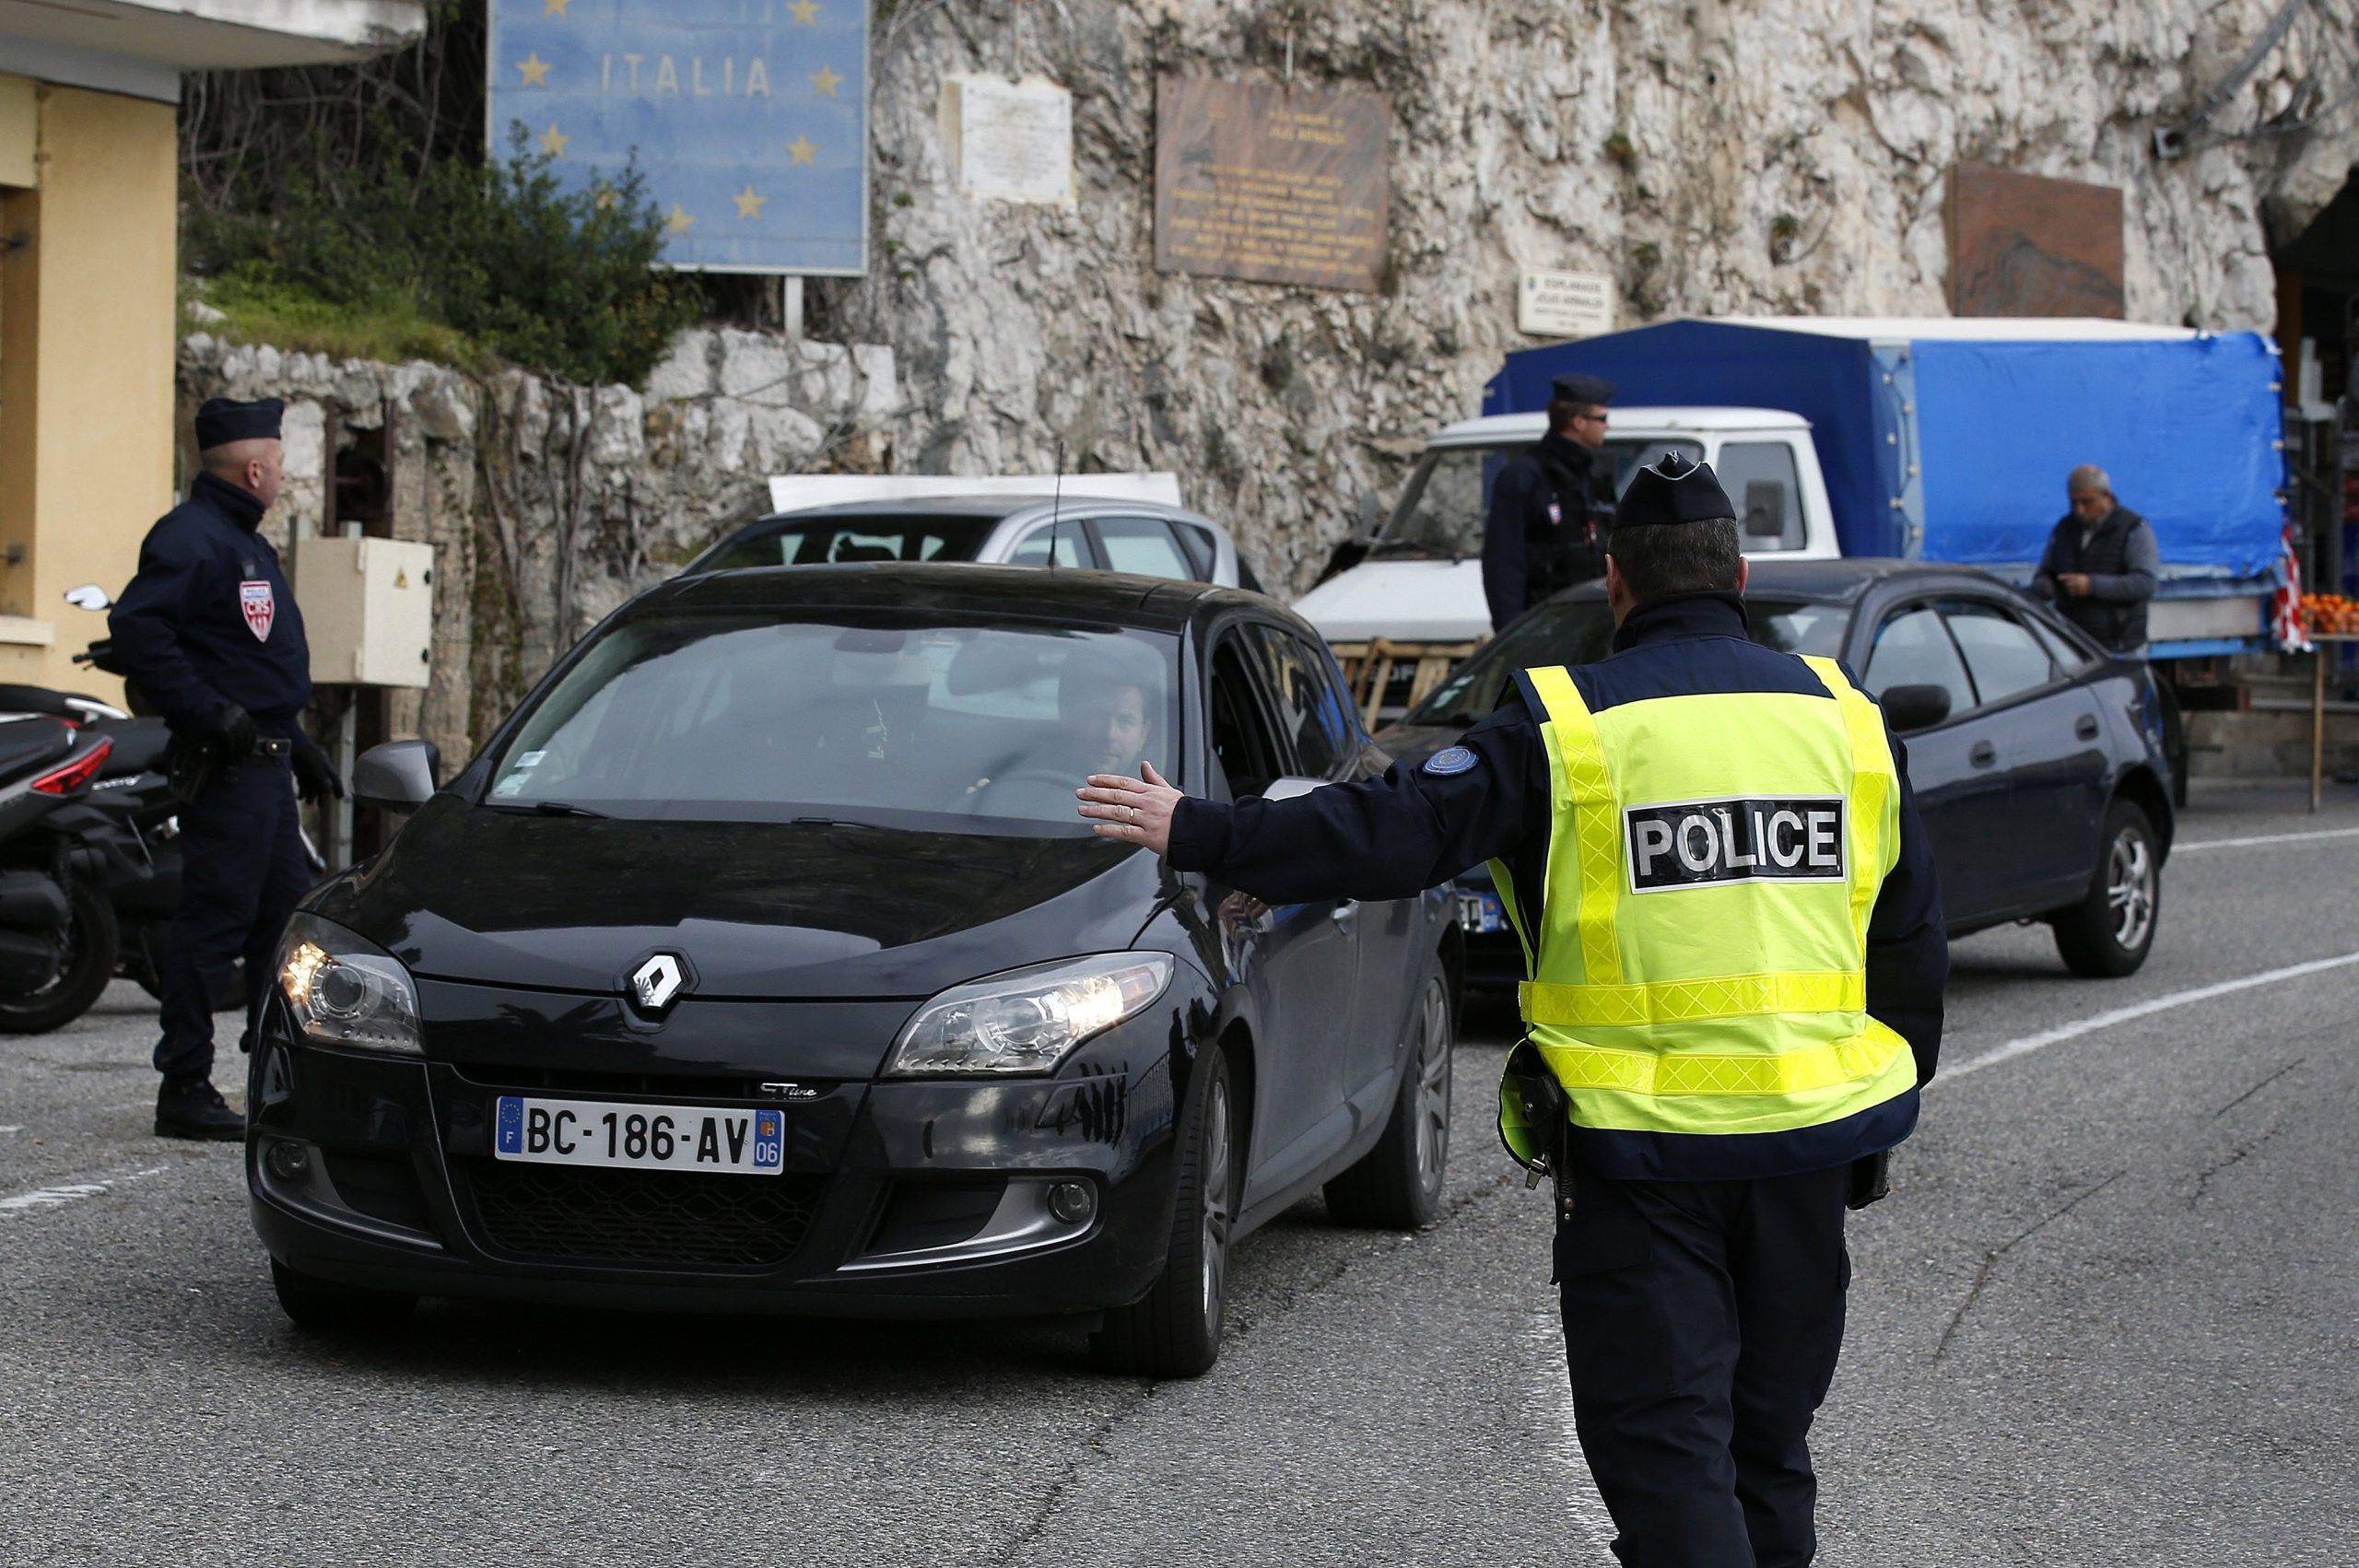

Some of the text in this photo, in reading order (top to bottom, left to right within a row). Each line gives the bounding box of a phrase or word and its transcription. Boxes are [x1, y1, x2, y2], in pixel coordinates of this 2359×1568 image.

[602, 53, 769, 98] ITALIA
[1635, 809, 1837, 876] POLICE
[506, 1131, 514, 1143] F
[527, 1107, 748, 1164] BC-186-AV
[756, 1141, 778, 1163] 06
